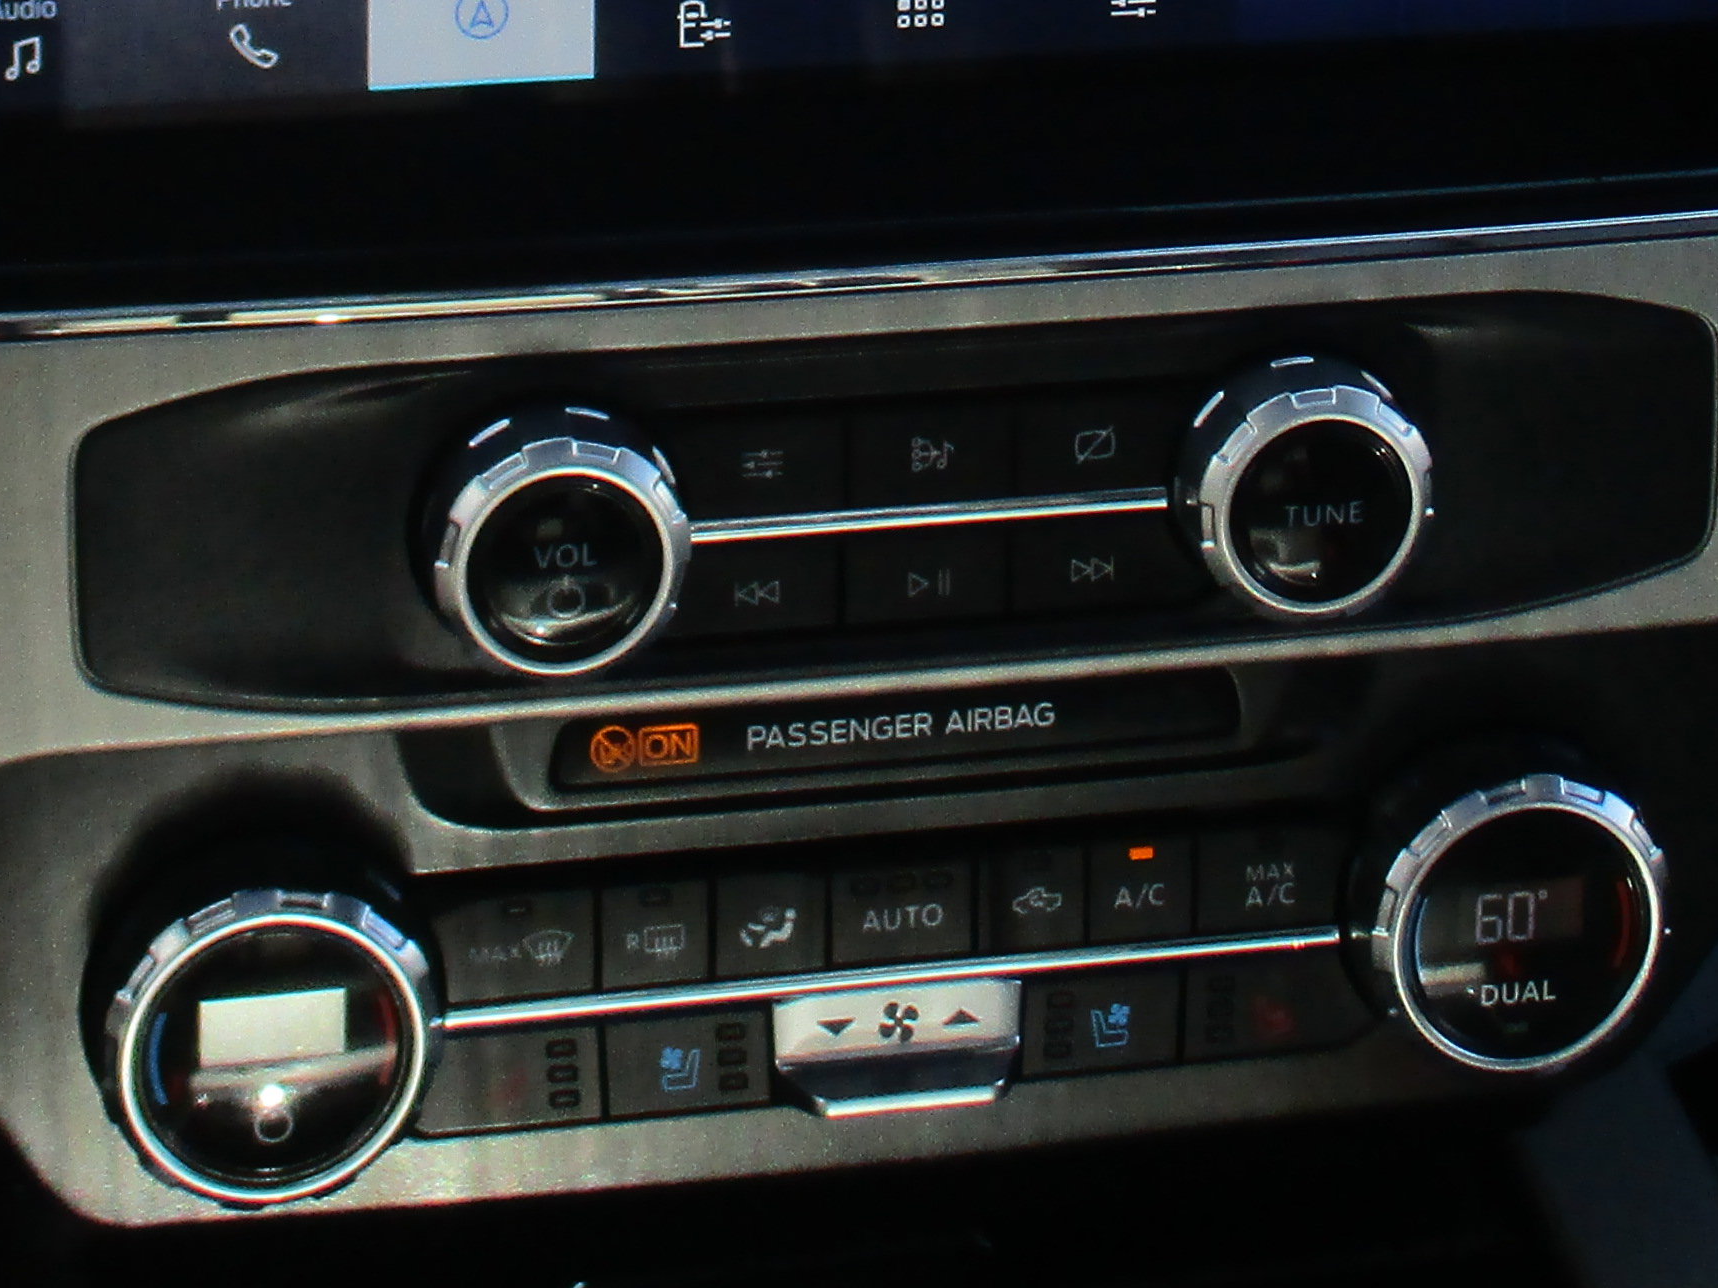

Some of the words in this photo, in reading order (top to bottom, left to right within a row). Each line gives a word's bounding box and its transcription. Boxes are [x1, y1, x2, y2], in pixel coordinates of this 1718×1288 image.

[1283, 500, 1364, 529] TUNE
[535, 544, 595, 569] VOL
[747, 713, 932, 751] PASSENGER
[945, 702, 1055, 732] AIRBAG
[643, 733, 694, 759] ON
[1246, 862, 1295, 880] MAX
[1114, 884, 1165, 909] A/C
[1245, 883, 1295, 908] A/C
[862, 905, 944, 932] AUTO
[1480, 980, 1556, 1008] DUAL
